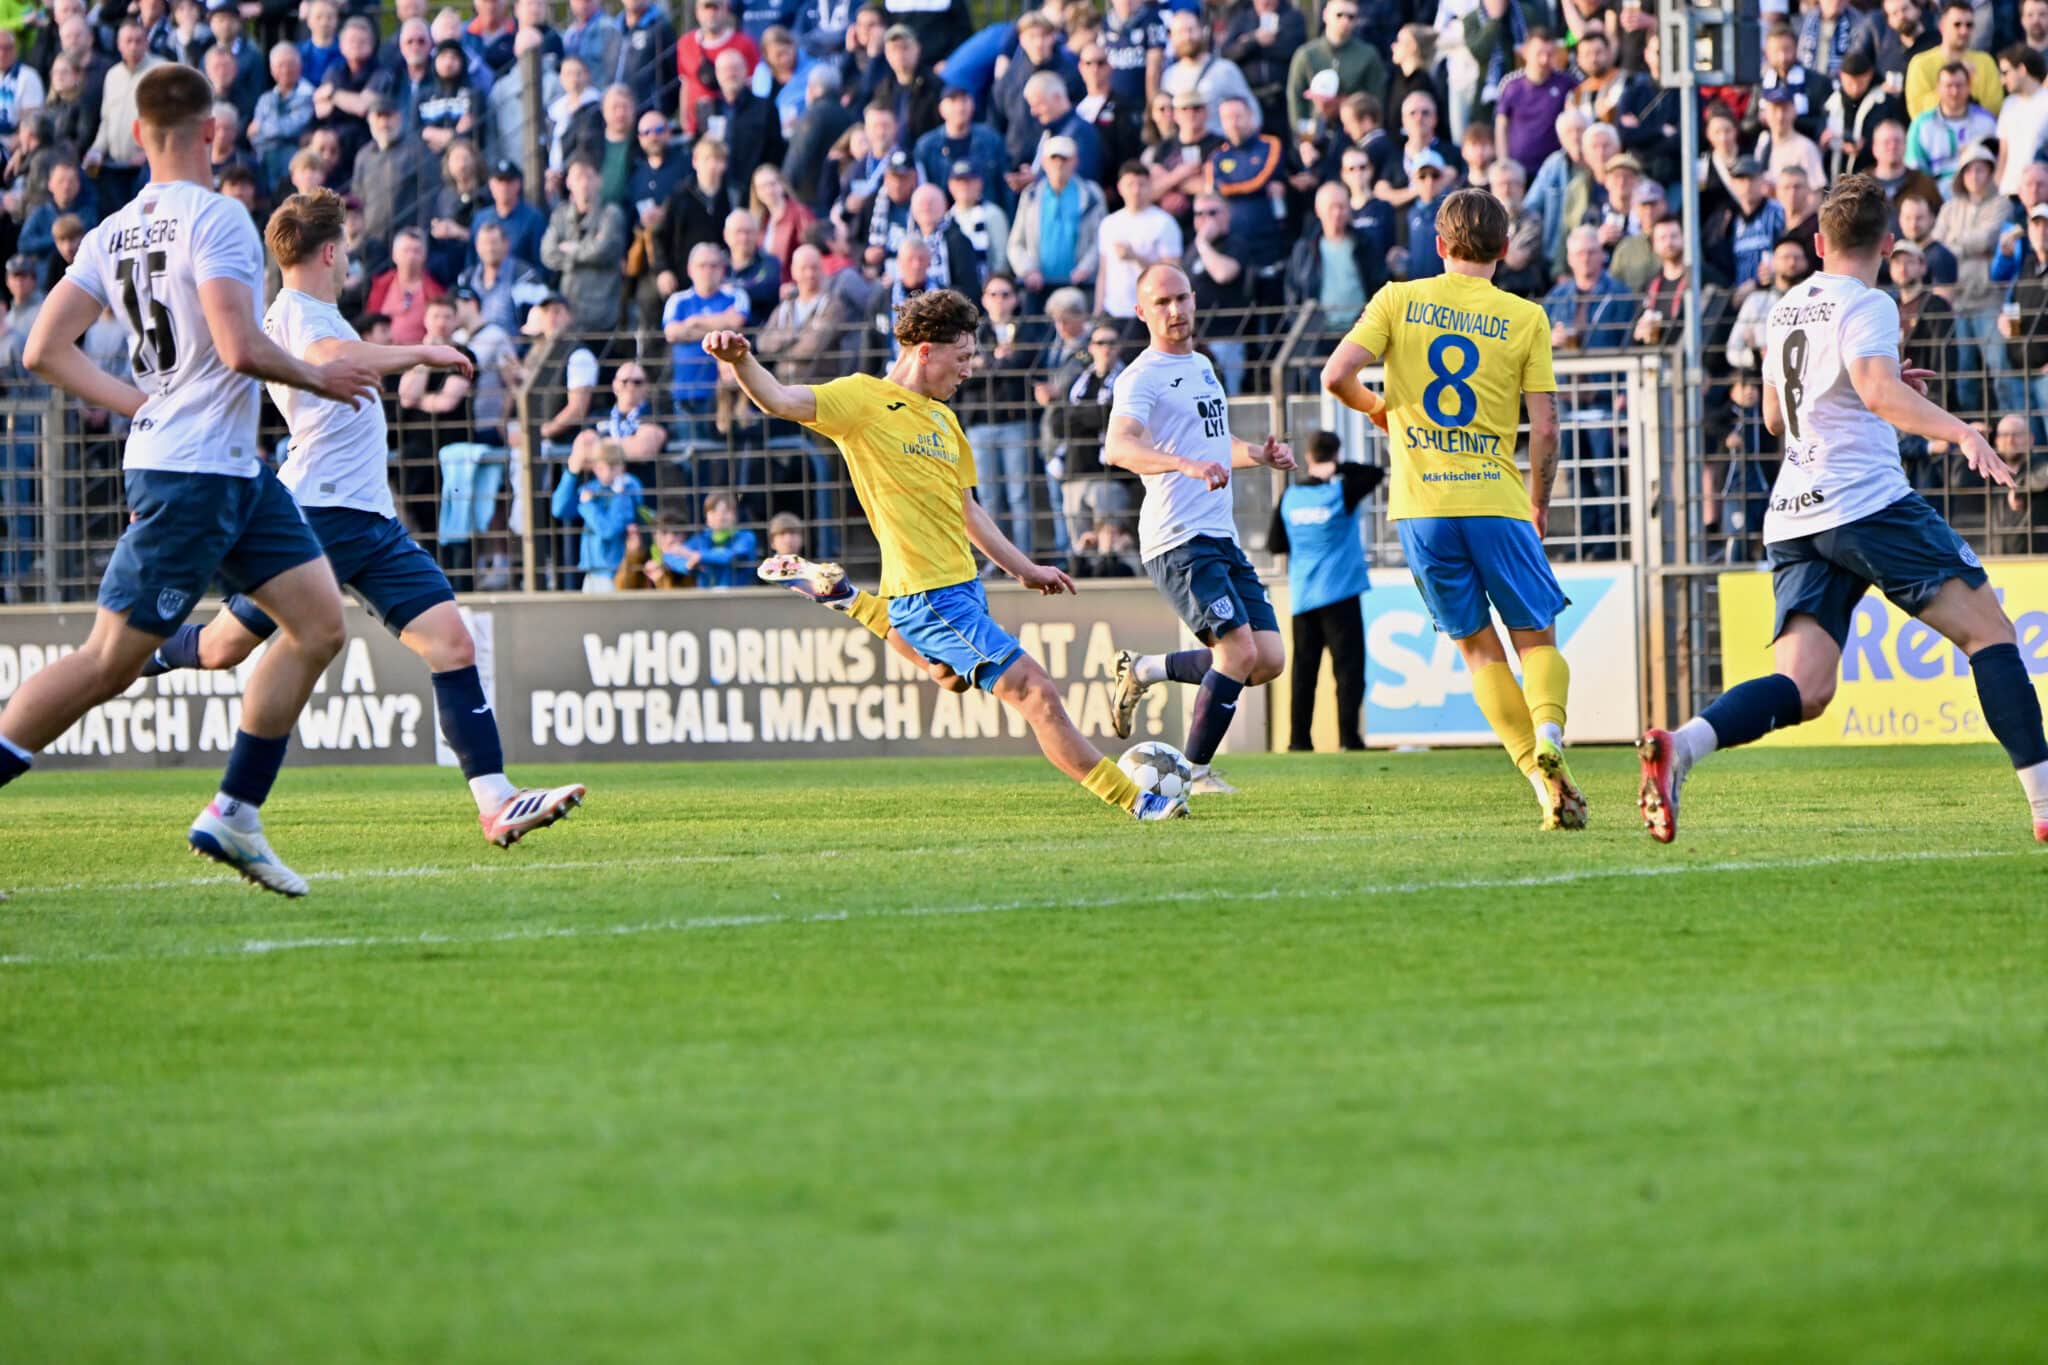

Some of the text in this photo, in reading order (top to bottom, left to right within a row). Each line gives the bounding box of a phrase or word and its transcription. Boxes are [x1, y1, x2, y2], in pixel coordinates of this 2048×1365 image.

[1406, 300, 1510, 341] LUCKENWALDE
[1423, 333, 1480, 427] 8
[1204, 417, 1225, 438] LY!
[1422, 472, 1481, 482] Märkischer
[342, 637, 376, 694] A
[582, 631, 700, 687] WHO
[708, 627, 876, 686] DRINKS
[531, 689, 754, 746] FOOTBALL
[760, 684, 922, 743] MATCH
